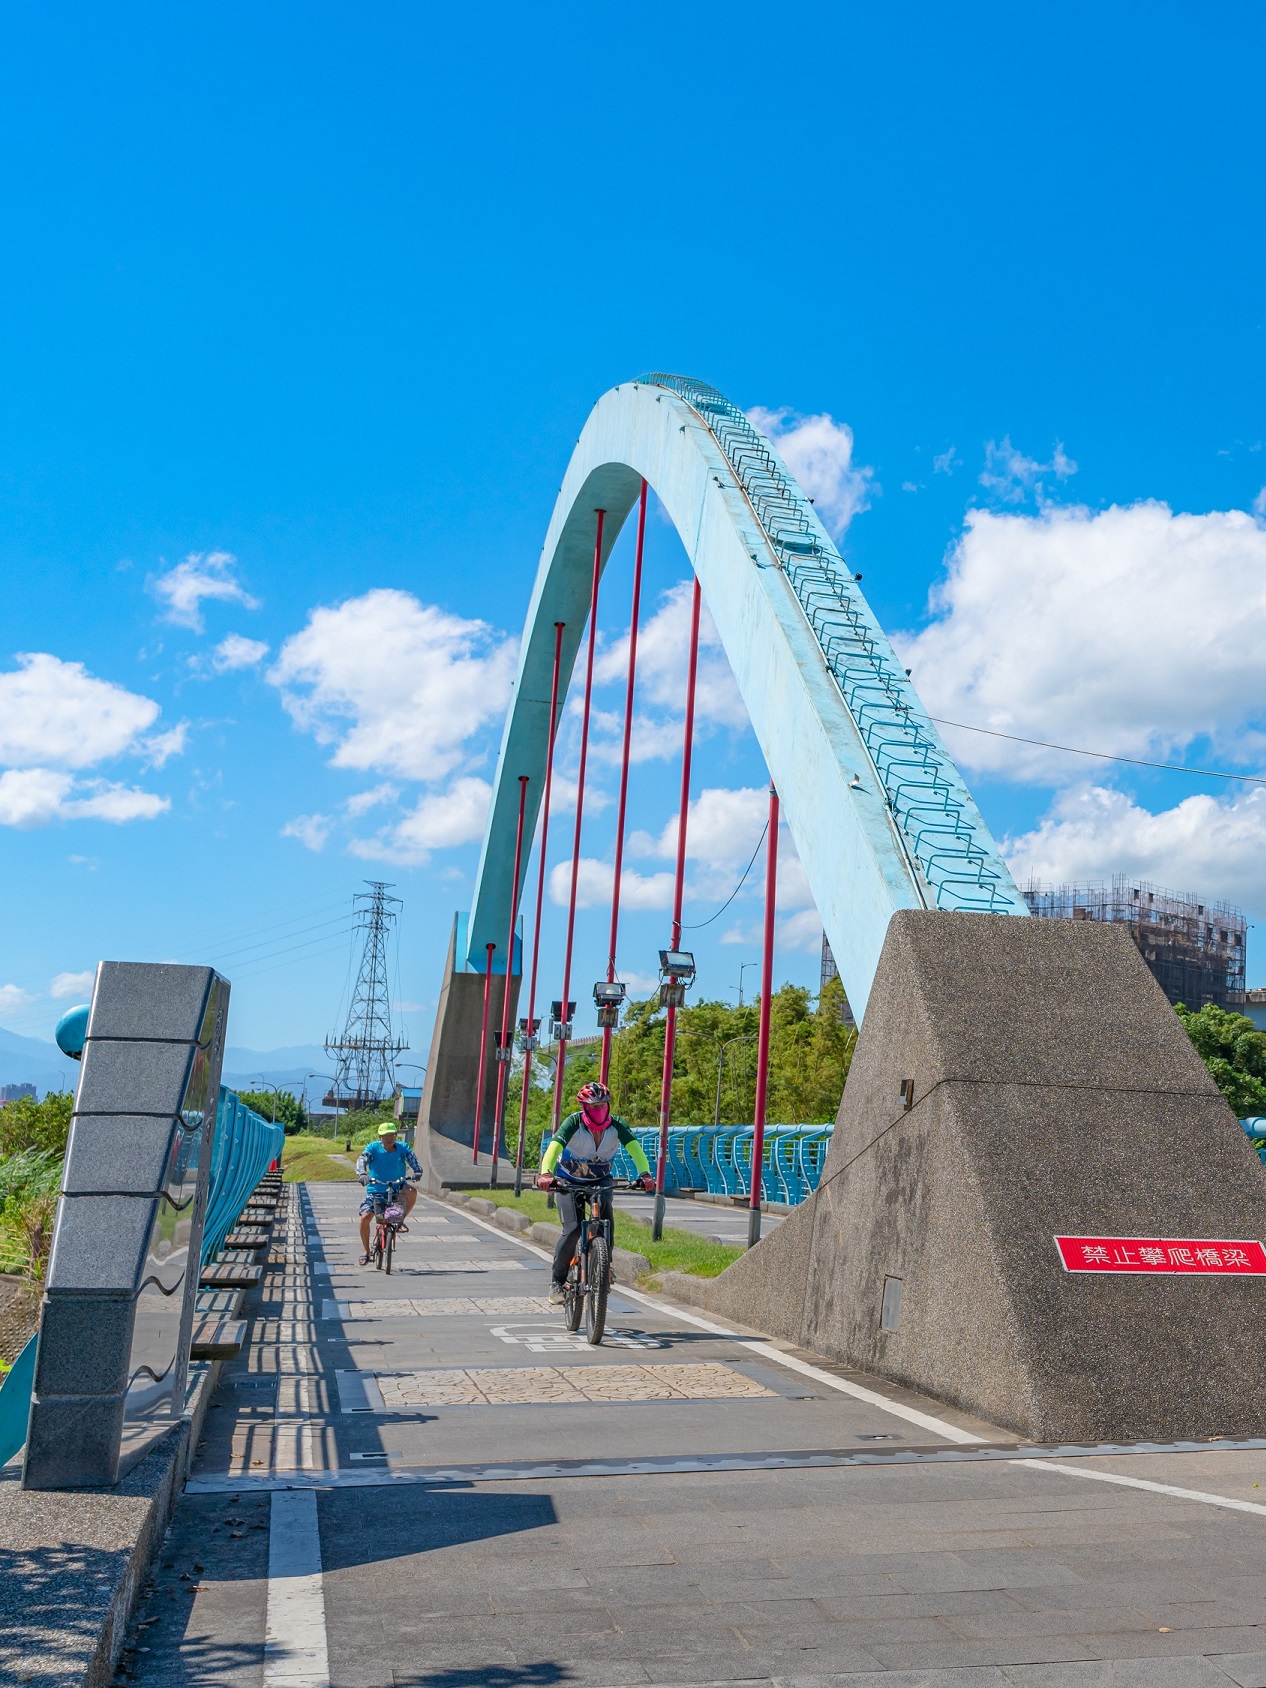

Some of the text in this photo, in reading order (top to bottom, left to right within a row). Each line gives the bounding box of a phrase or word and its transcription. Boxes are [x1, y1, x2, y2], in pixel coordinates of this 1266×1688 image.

[1080, 1245, 1252, 1267] 禁止攀爬橋梁
